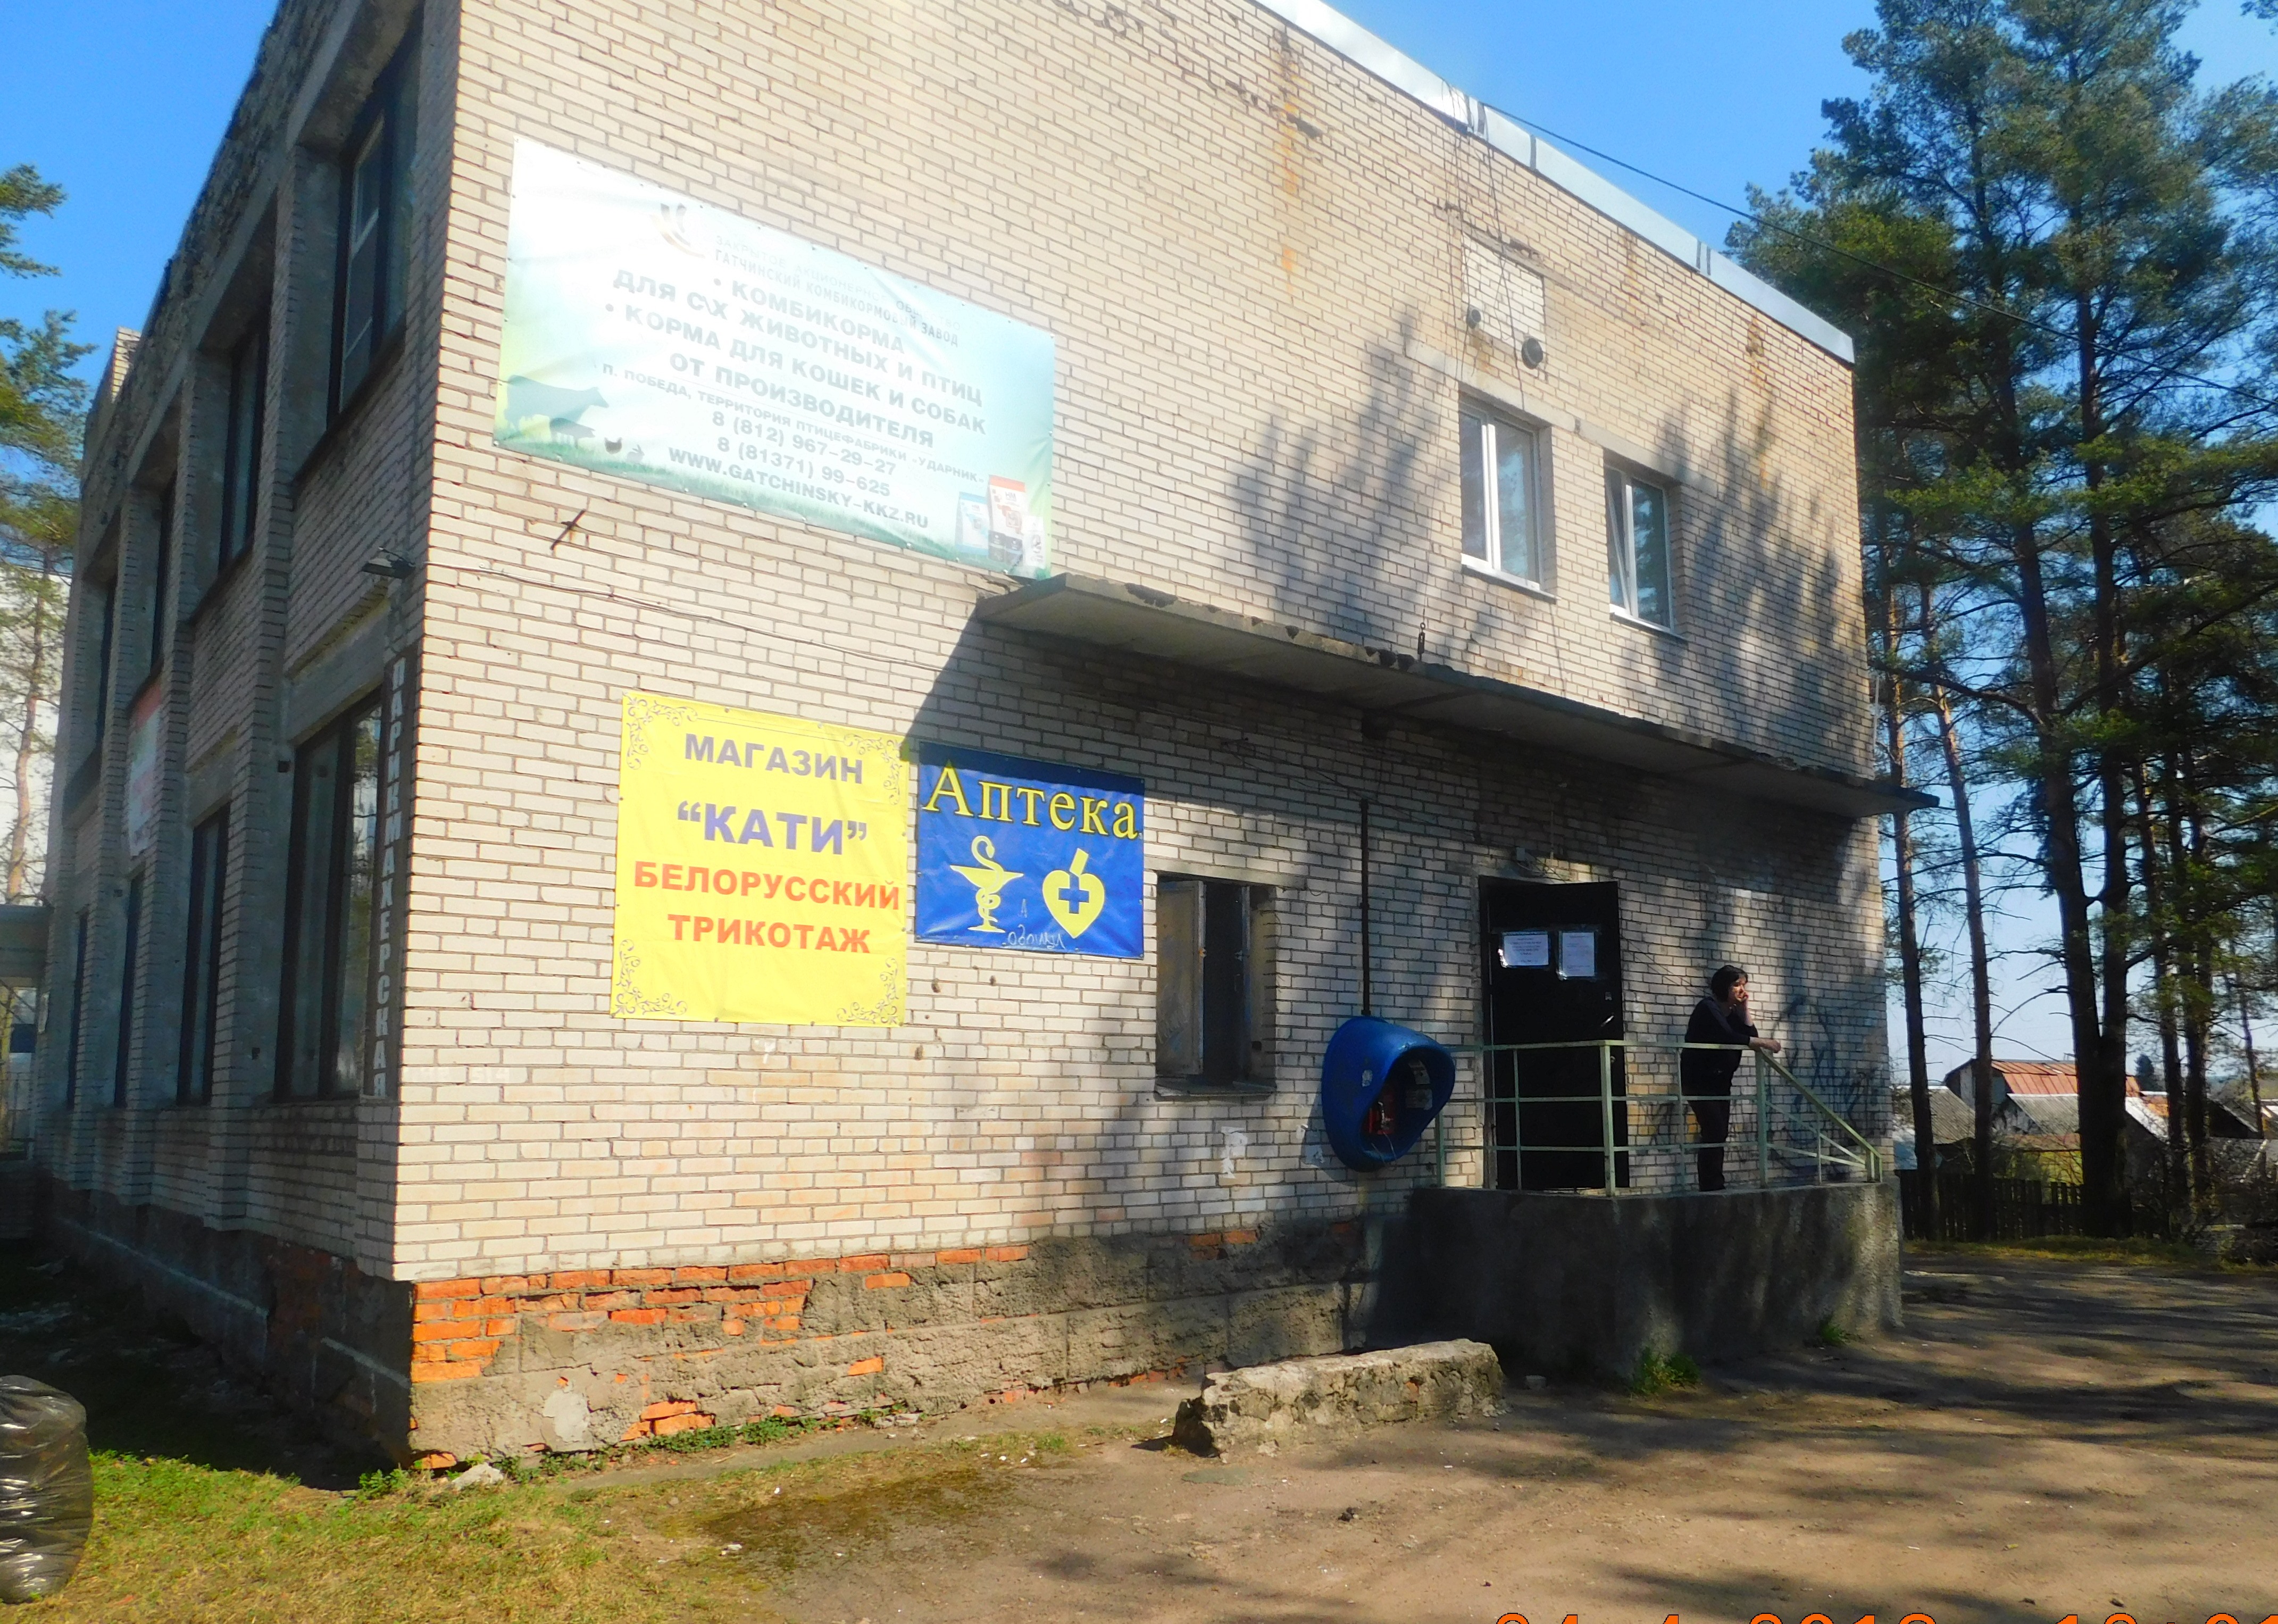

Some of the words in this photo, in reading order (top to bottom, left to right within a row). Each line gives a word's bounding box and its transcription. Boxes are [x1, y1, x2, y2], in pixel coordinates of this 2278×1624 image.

[716, 235, 786, 266] ЗАКРЫТОЕ
[715, 249, 800, 289] ГАТЧИНСКИЙ
[921, 322, 958, 348] ЗАВОД
[732, 280, 905, 354] КОМБИКОРМА
[613, 269, 676, 302] ДЛЯ
[739, 309, 888, 373] ЖИВОТНЫХ
[897, 362, 912, 381] И
[922, 370, 982, 407] ПТИЦ
[625, 304, 721, 351] КОРМА
[729, 338, 783, 370] ДЛЯ
[792, 358, 881, 401] КОШЕК
[889, 389, 904, 409] И
[912, 397, 986, 435] СОБАК
[603, 363, 618, 377] П.
[624, 369, 691, 400] ПОБЕДА,
[697, 390, 790, 427] ТЕРРИТОРИЯ
[796, 420, 907, 462] ПТИЦЕФАБРИКИ
[670, 353, 705, 377] ОТ
[715, 365, 933, 448] ПРОИЗВОДИТЕЛЯ
[712, 411, 724, 427] 8
[733, 417, 784, 447] (812)
[792, 434, 896, 476] 967-29-27
[717, 436, 730, 452] 8
[738, 442, 814, 479] (81371)
[822, 465, 890, 497] 99-625
[669, 447, 928, 528] WWW.GATCHINSKY-KKZ.RU
[685, 732, 863, 785] МАГАЗИН
[923, 759, 1138, 840] Аптека
[634, 861, 900, 911] БЕЛОРУССКИЙ
[668, 914, 870, 954] ТРИКОТАЖ
